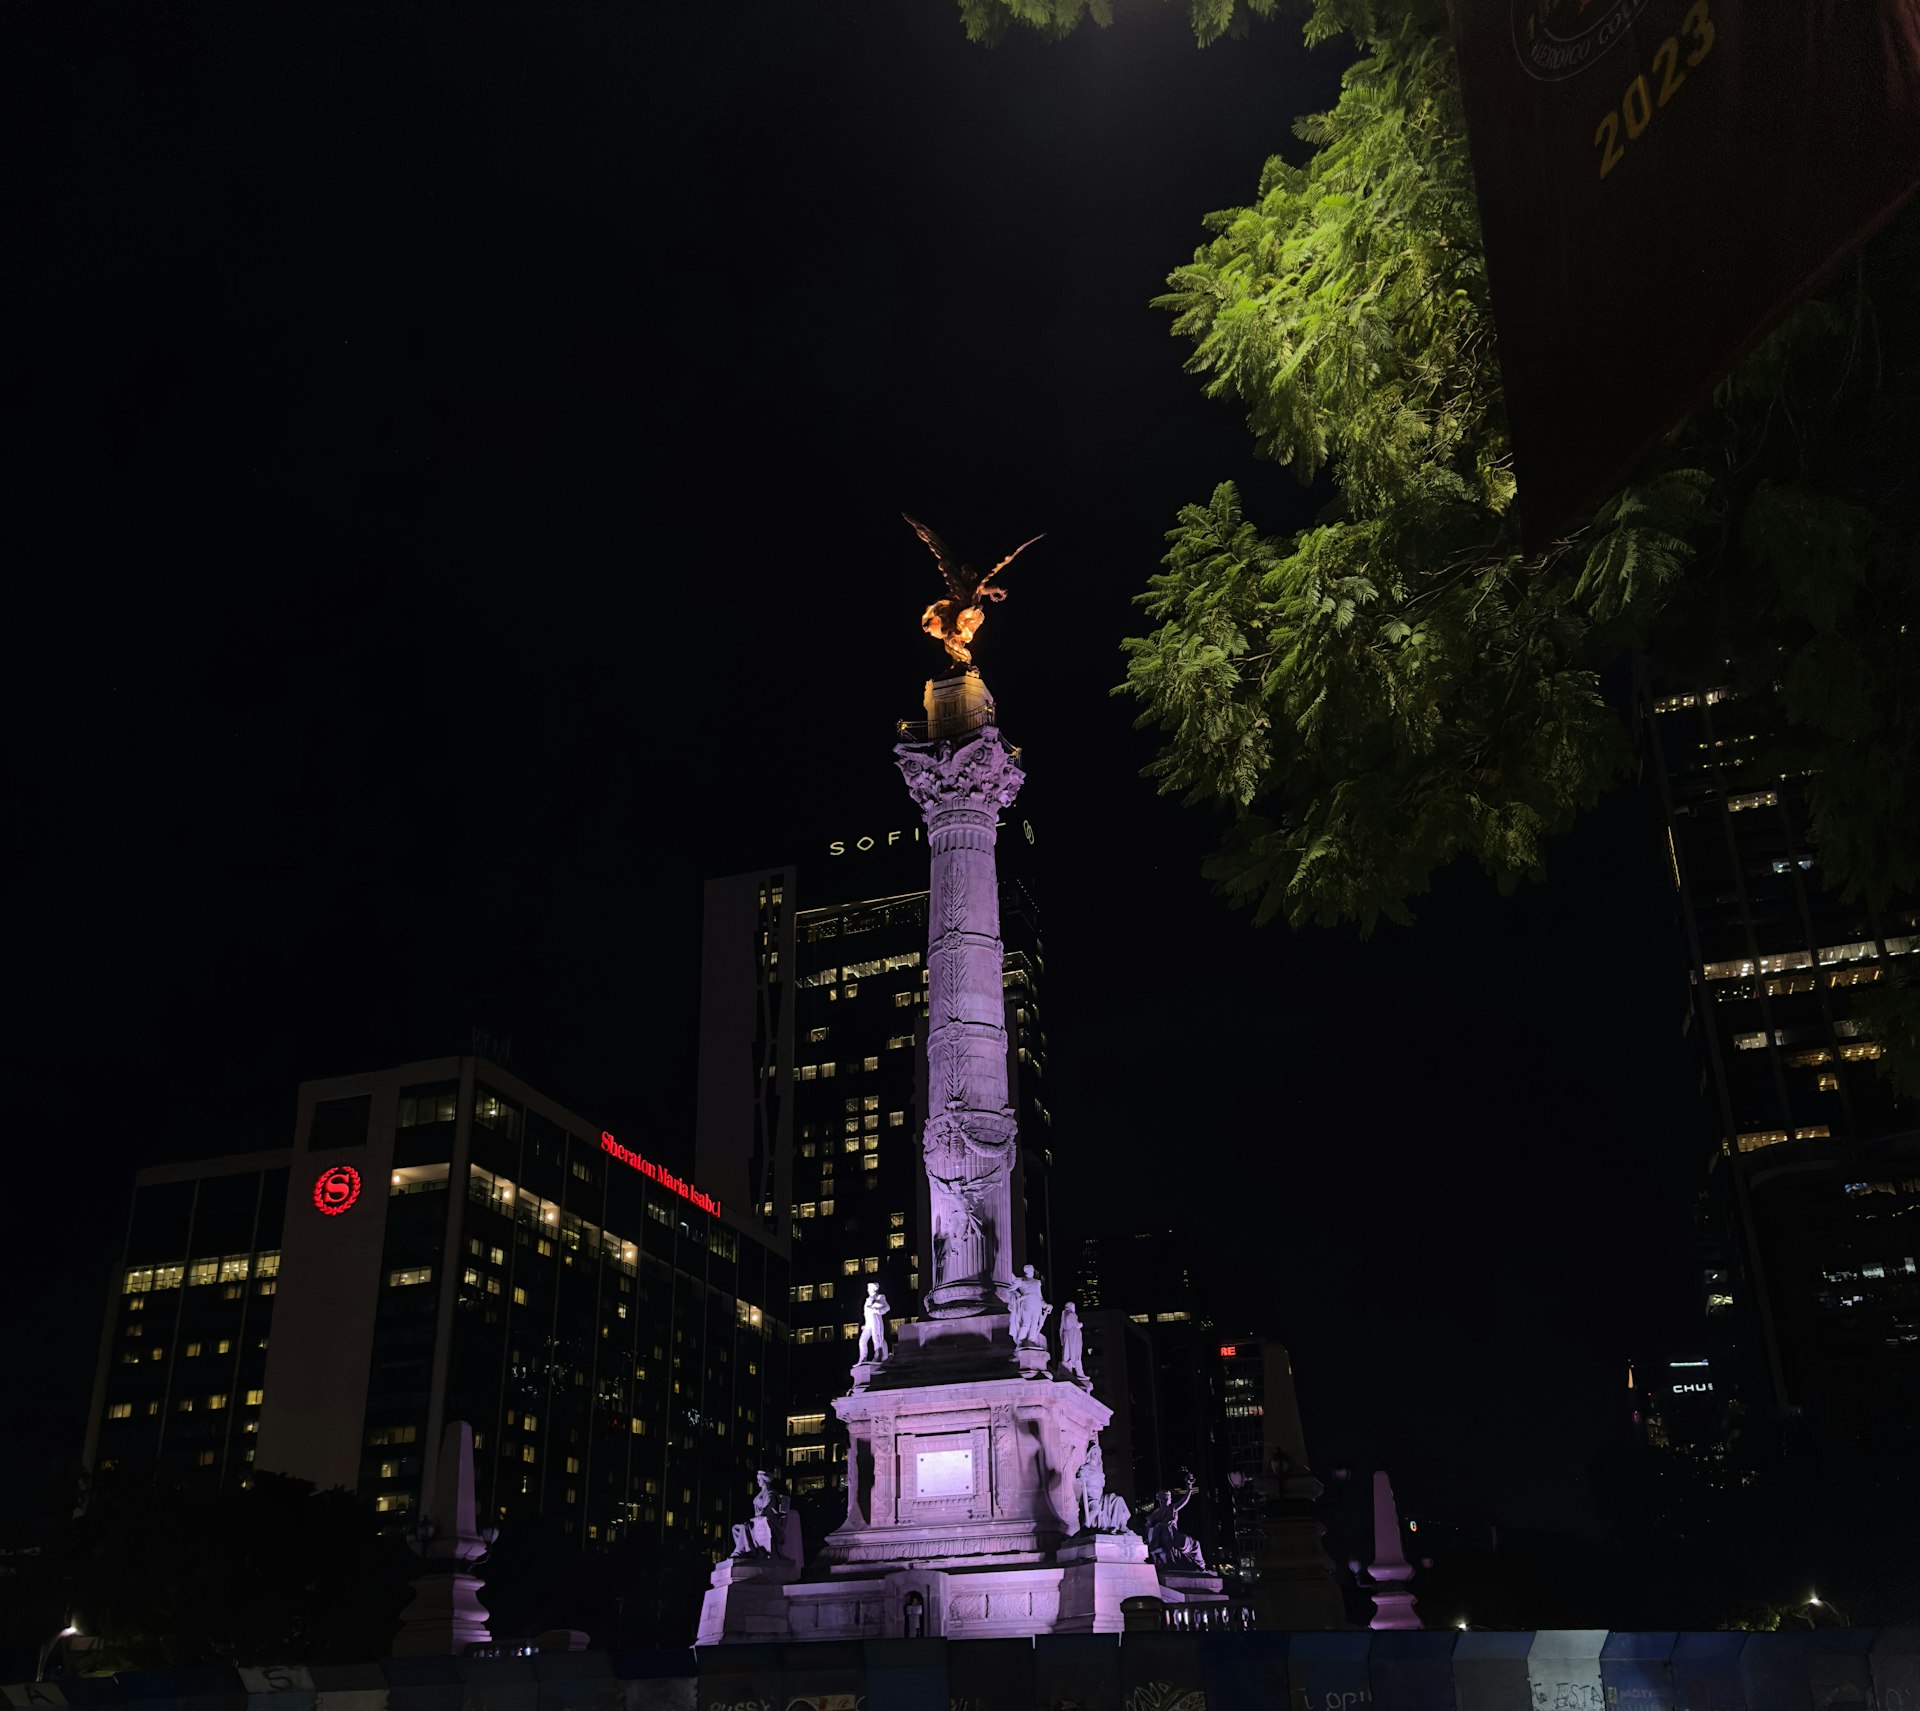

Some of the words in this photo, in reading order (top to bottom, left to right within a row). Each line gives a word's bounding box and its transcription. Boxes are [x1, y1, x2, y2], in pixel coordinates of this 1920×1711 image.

[1594, 0, 1716, 181] 2023
[601, 1130, 657, 1180] Sheraton
[324, 1173, 350, 1203] S
